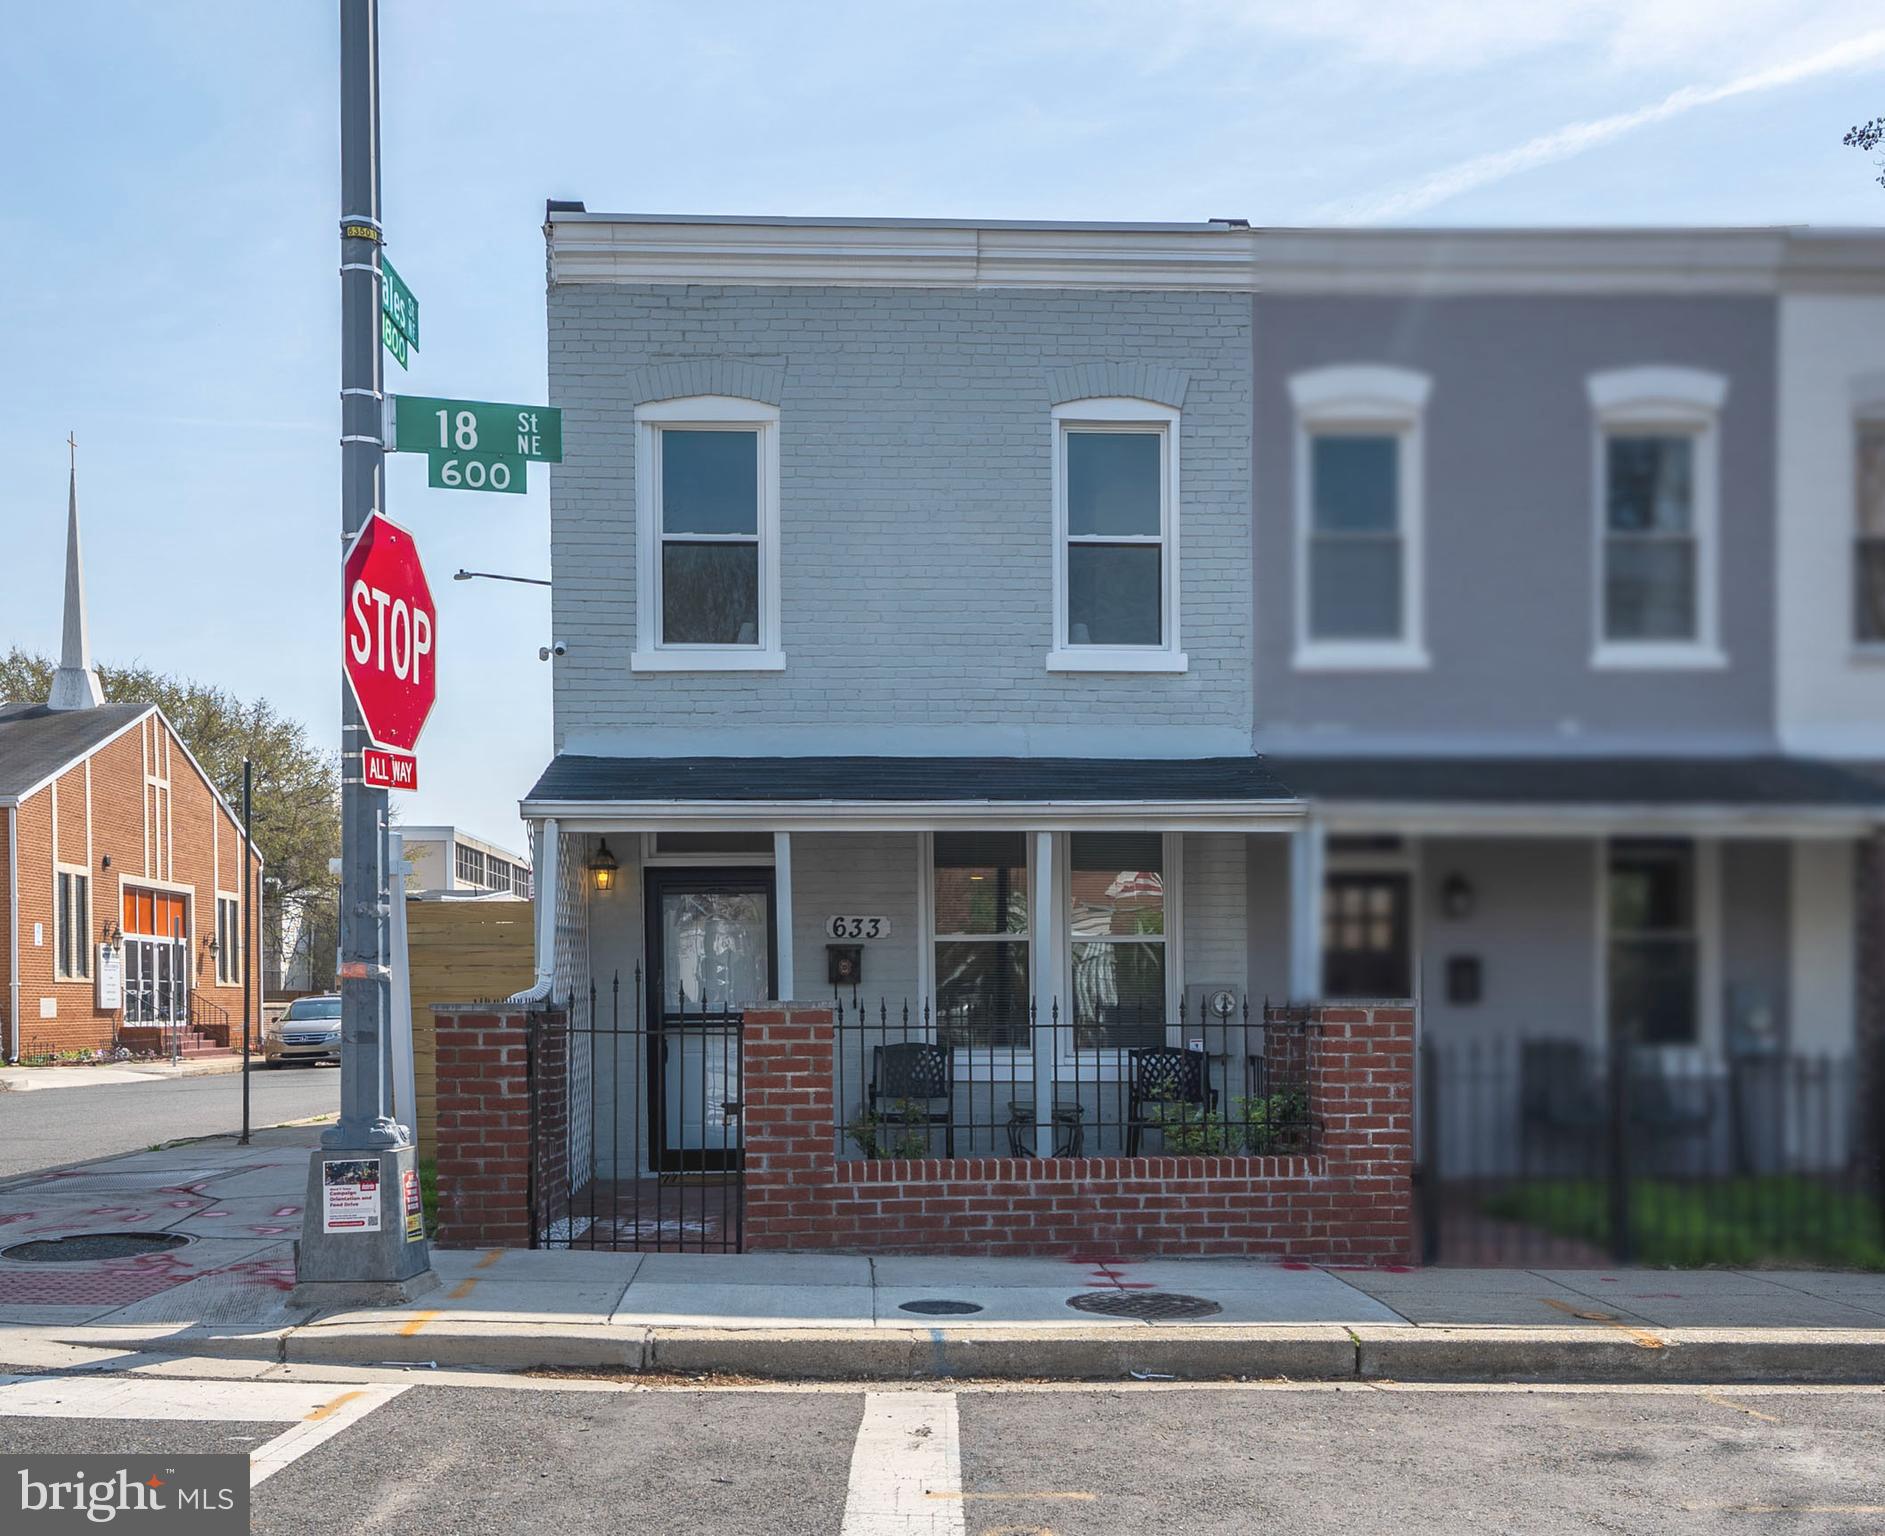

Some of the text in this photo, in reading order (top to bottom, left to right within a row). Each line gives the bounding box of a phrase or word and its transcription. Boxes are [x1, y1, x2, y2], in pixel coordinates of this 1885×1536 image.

[382, 275, 406, 329] ales
[435, 409, 539, 451] 18 St
[517, 434, 542, 456] NE
[441, 459, 511, 490] 600
[350, 579, 432, 685] STOP
[370, 757, 413, 783] ALL WAY
[832, 916, 881, 938] 633
